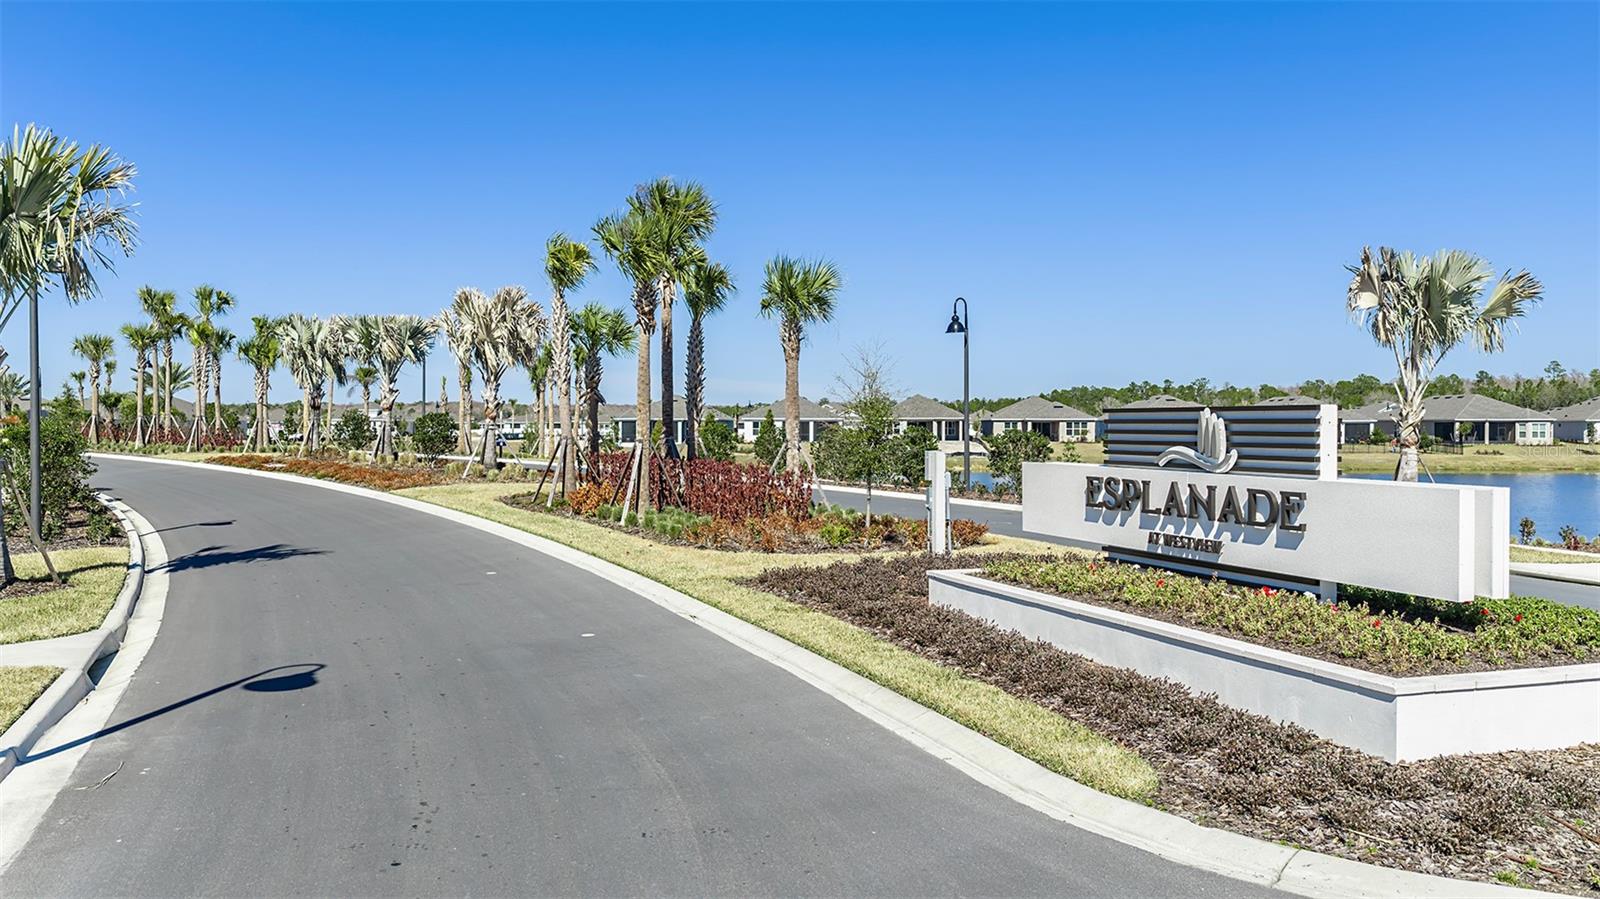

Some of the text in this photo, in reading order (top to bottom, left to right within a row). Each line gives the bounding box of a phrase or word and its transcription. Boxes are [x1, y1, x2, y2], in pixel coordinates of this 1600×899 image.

[1086, 476, 1307, 532] ESPLANADE
[1148, 531, 1223, 554] AT WESTVIEW
